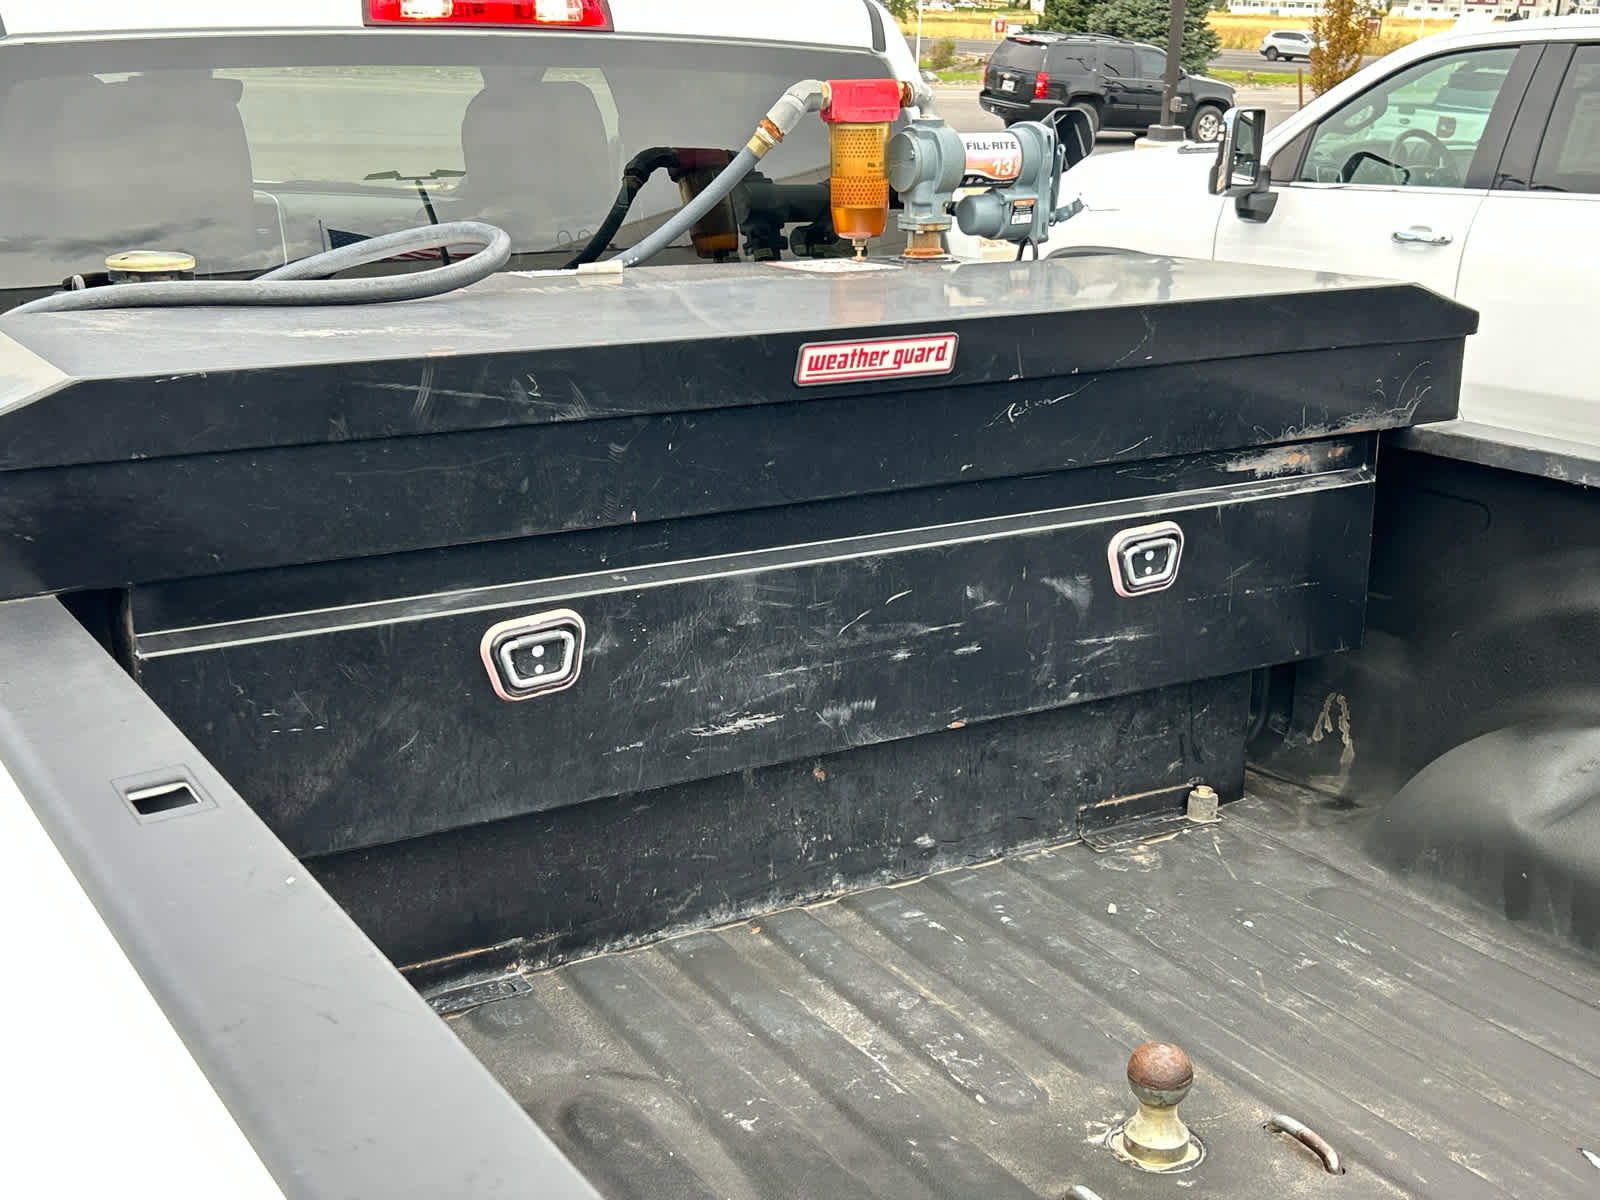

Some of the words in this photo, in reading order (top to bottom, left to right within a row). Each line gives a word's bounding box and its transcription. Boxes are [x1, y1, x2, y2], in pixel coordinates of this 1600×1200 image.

[965, 141, 1017, 151] FILL-RITE
[807, 348, 889, 371] weather
[893, 341, 948, 369] guard
